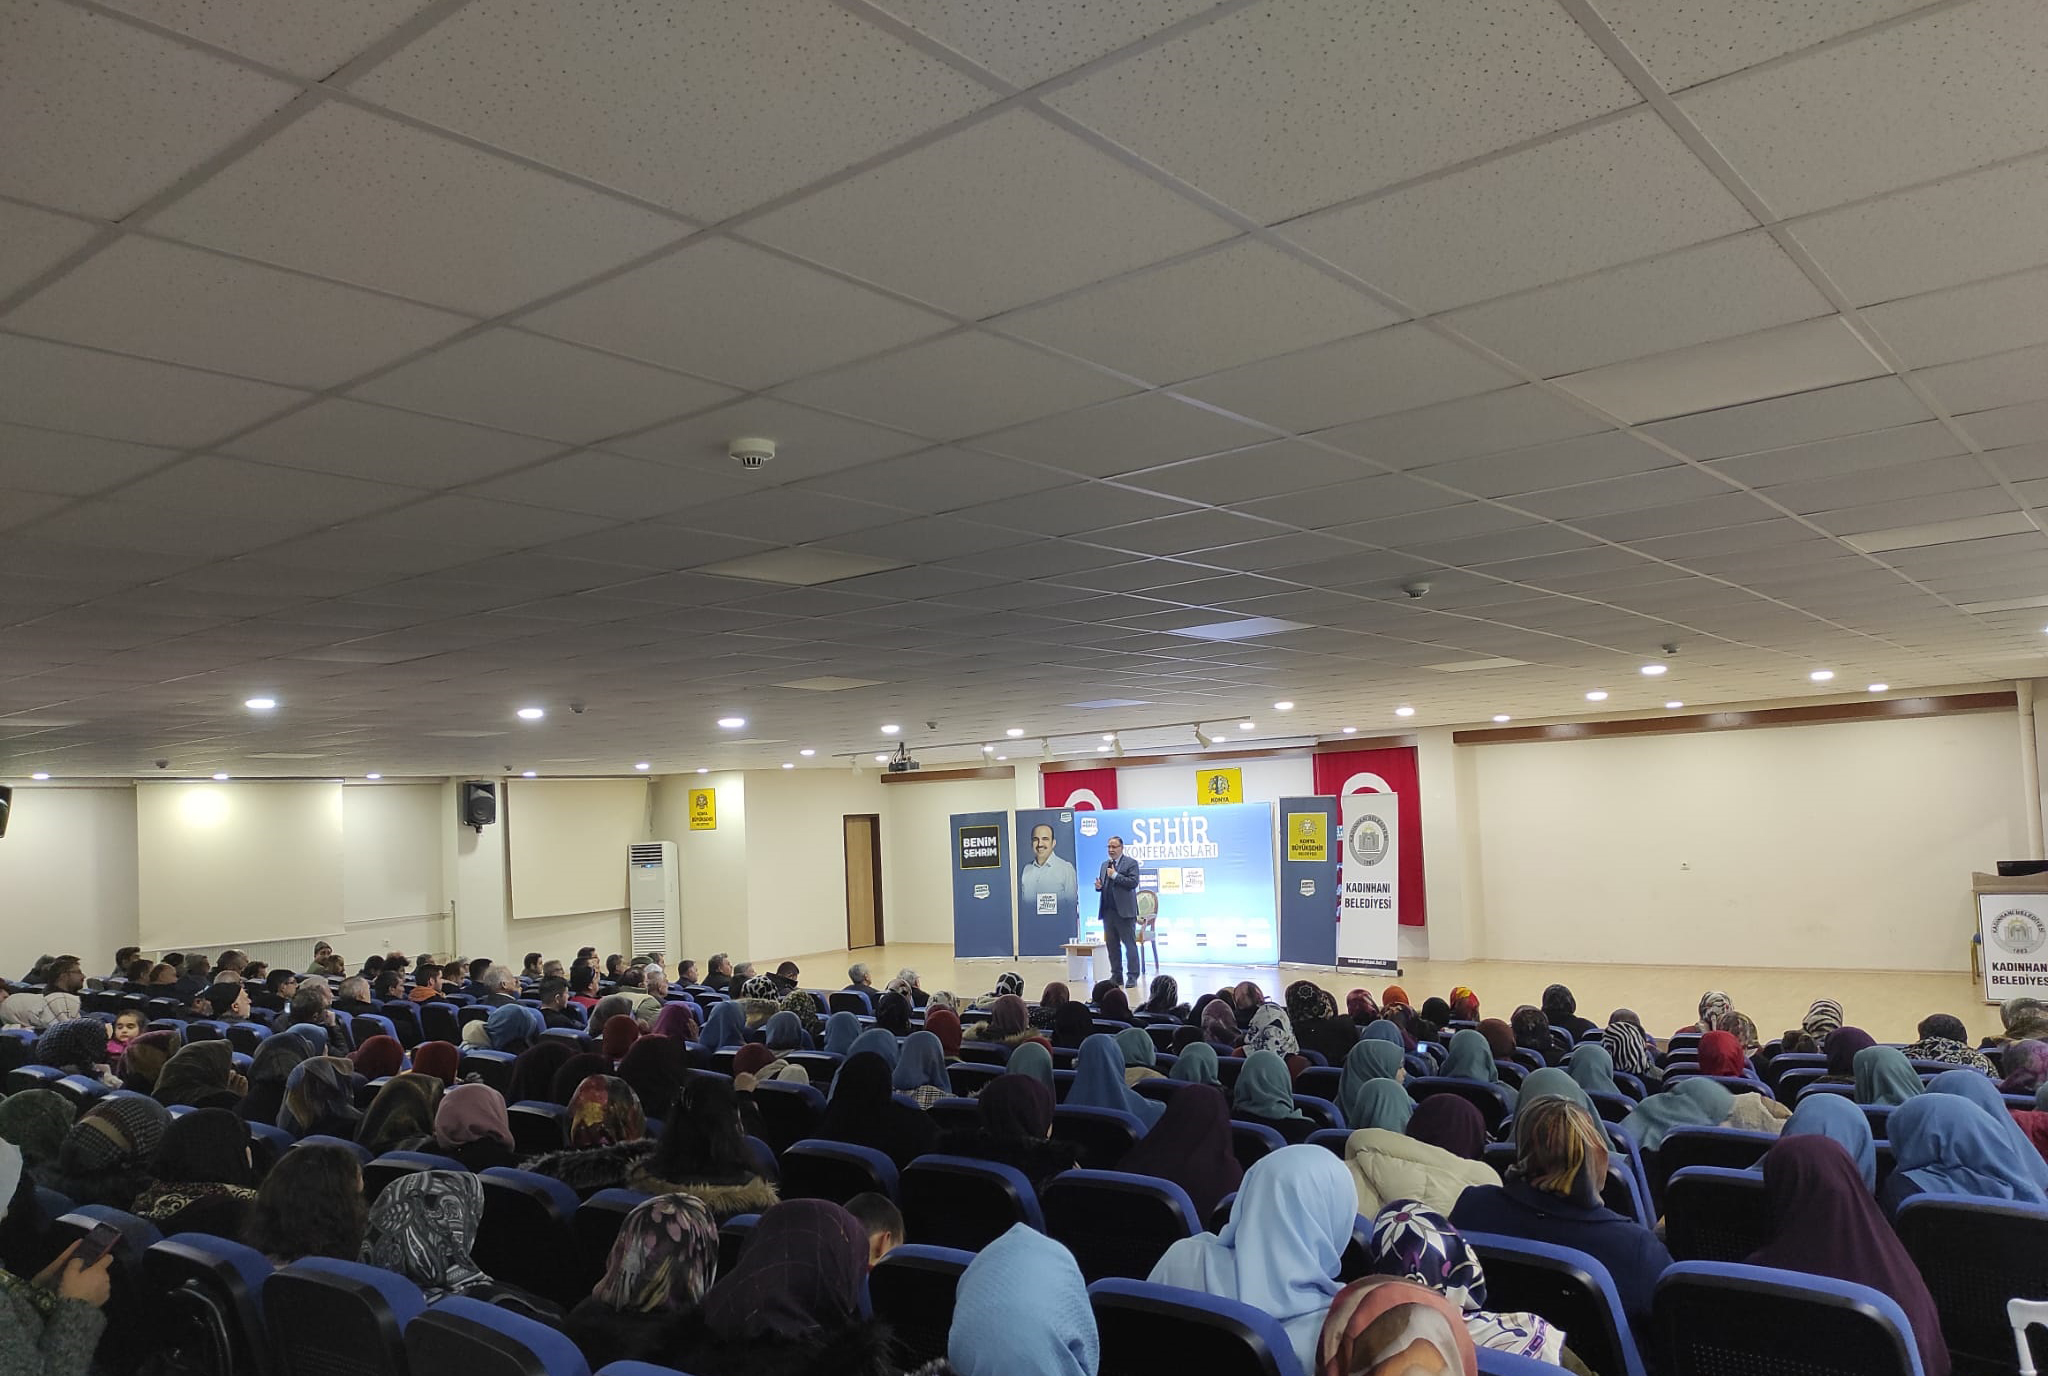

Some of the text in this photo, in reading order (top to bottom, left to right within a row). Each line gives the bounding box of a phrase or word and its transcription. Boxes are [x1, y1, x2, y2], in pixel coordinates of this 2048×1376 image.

[963, 835, 997, 848] BENİM
[1291, 843, 1324, 852] BÜYÜKŞEHİR
[963, 847, 998, 860] ŞEHRİM
[1124, 843, 1216, 859] KONFERANSLARI
[1345, 882, 1390, 894] KADINHANI
[1344, 895, 1392, 909] BELEDİYESİ
